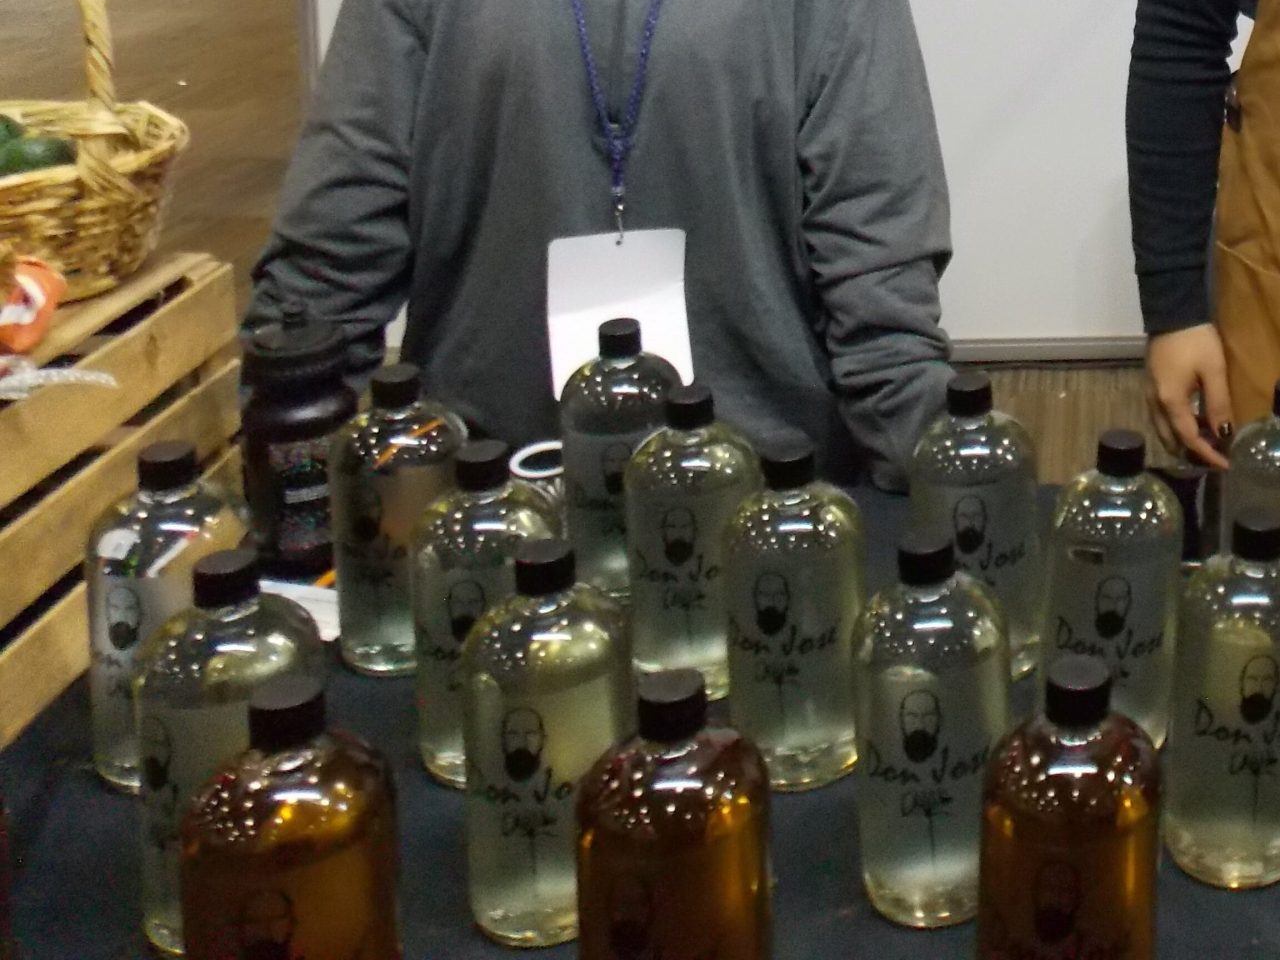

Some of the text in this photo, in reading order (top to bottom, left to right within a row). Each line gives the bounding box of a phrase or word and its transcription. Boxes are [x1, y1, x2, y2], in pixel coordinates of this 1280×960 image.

[1056, 614, 1107, 658] Don
[1195, 696, 1253, 745] Don
[866, 739, 921, 786] Don
